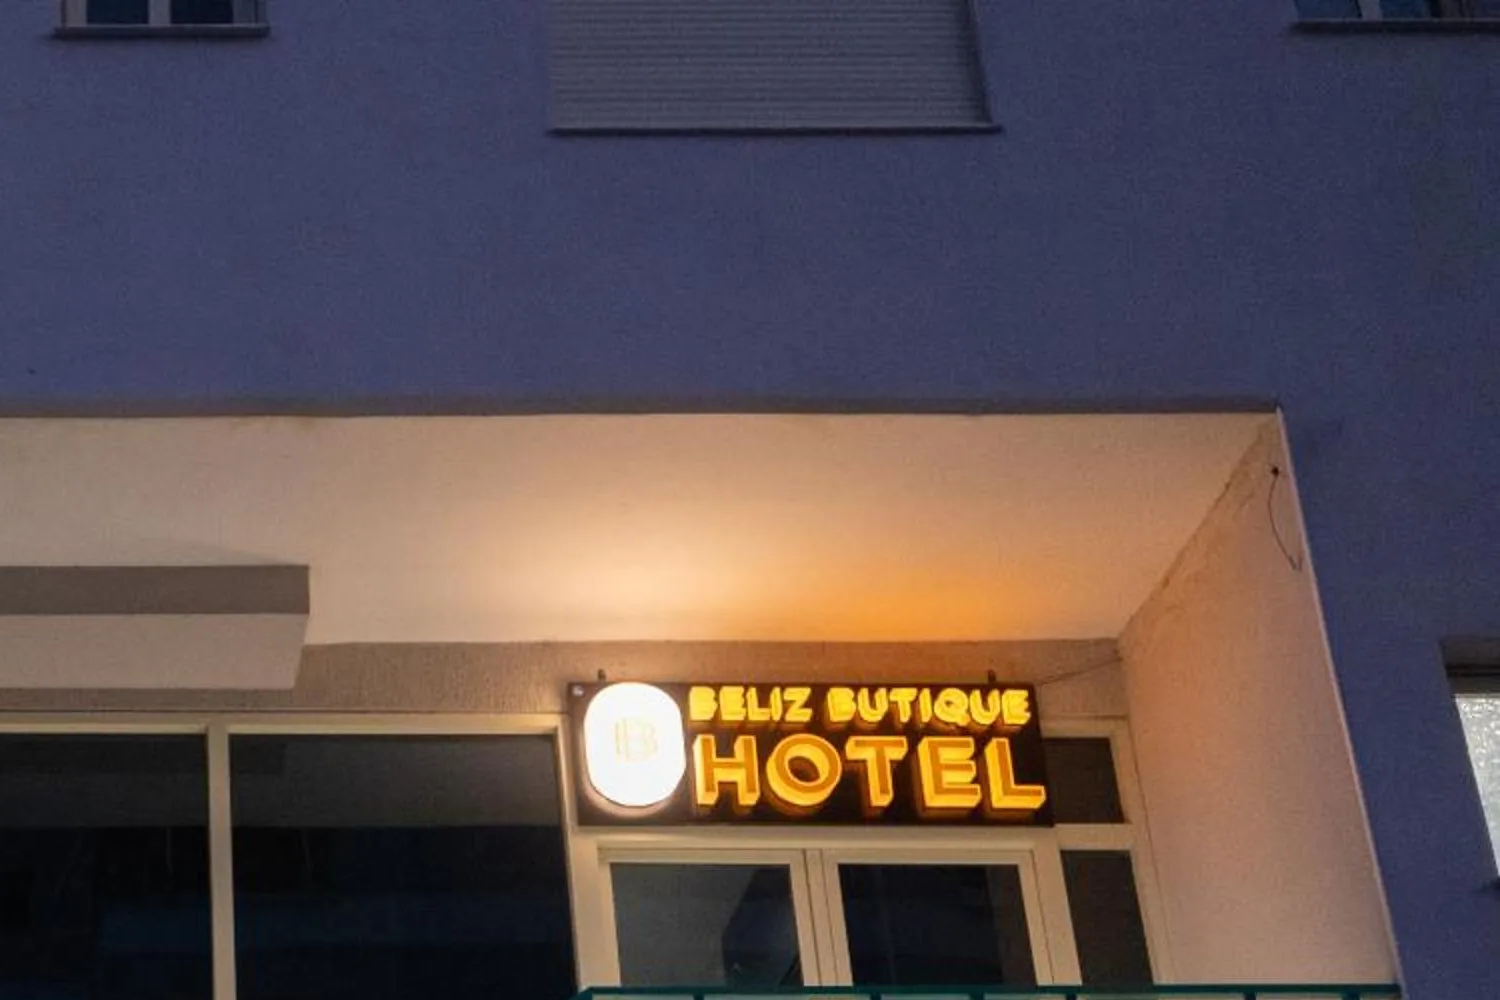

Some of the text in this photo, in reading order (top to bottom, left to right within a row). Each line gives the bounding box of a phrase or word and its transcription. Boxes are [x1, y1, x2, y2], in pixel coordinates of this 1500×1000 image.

[689, 686, 1031, 727] BELIZ BUTIQUE
[692, 733, 1046, 809] HOTEL
